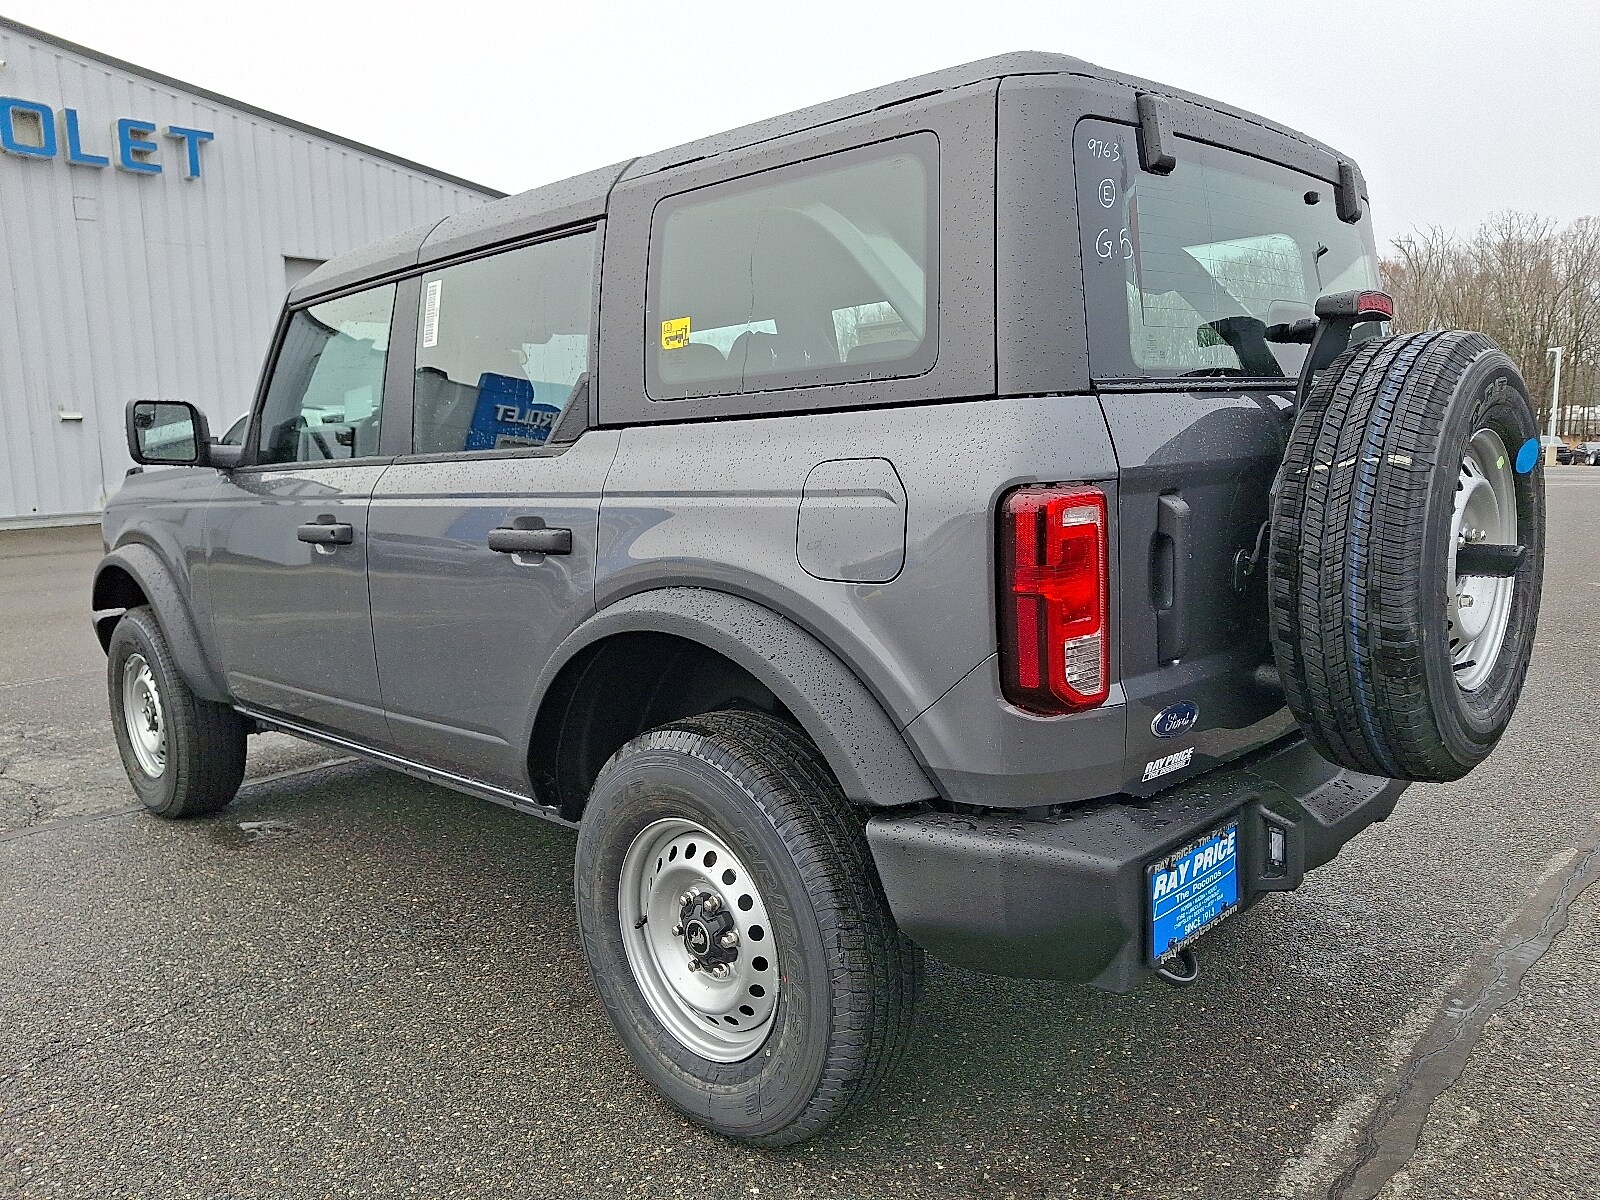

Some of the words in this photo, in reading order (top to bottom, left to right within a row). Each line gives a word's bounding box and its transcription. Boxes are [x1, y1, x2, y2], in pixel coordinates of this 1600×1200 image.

[0, 96, 215, 181] OLET
[1087, 138, 1121, 162] 9763
[1164, 711, 1190, 732] Ford
[1145, 757, 1167, 774] RAY
[1165, 746, 1195, 766] PRICE
[1153, 860, 1190, 899] RAY
[1192, 831, 1236, 878] PRICE
[1171, 844, 1193, 862] PRICE
[1175, 890, 1190, 903] The
[1192, 870, 1222, 893] Poconos
[1184, 916, 1202, 935] SINCE
